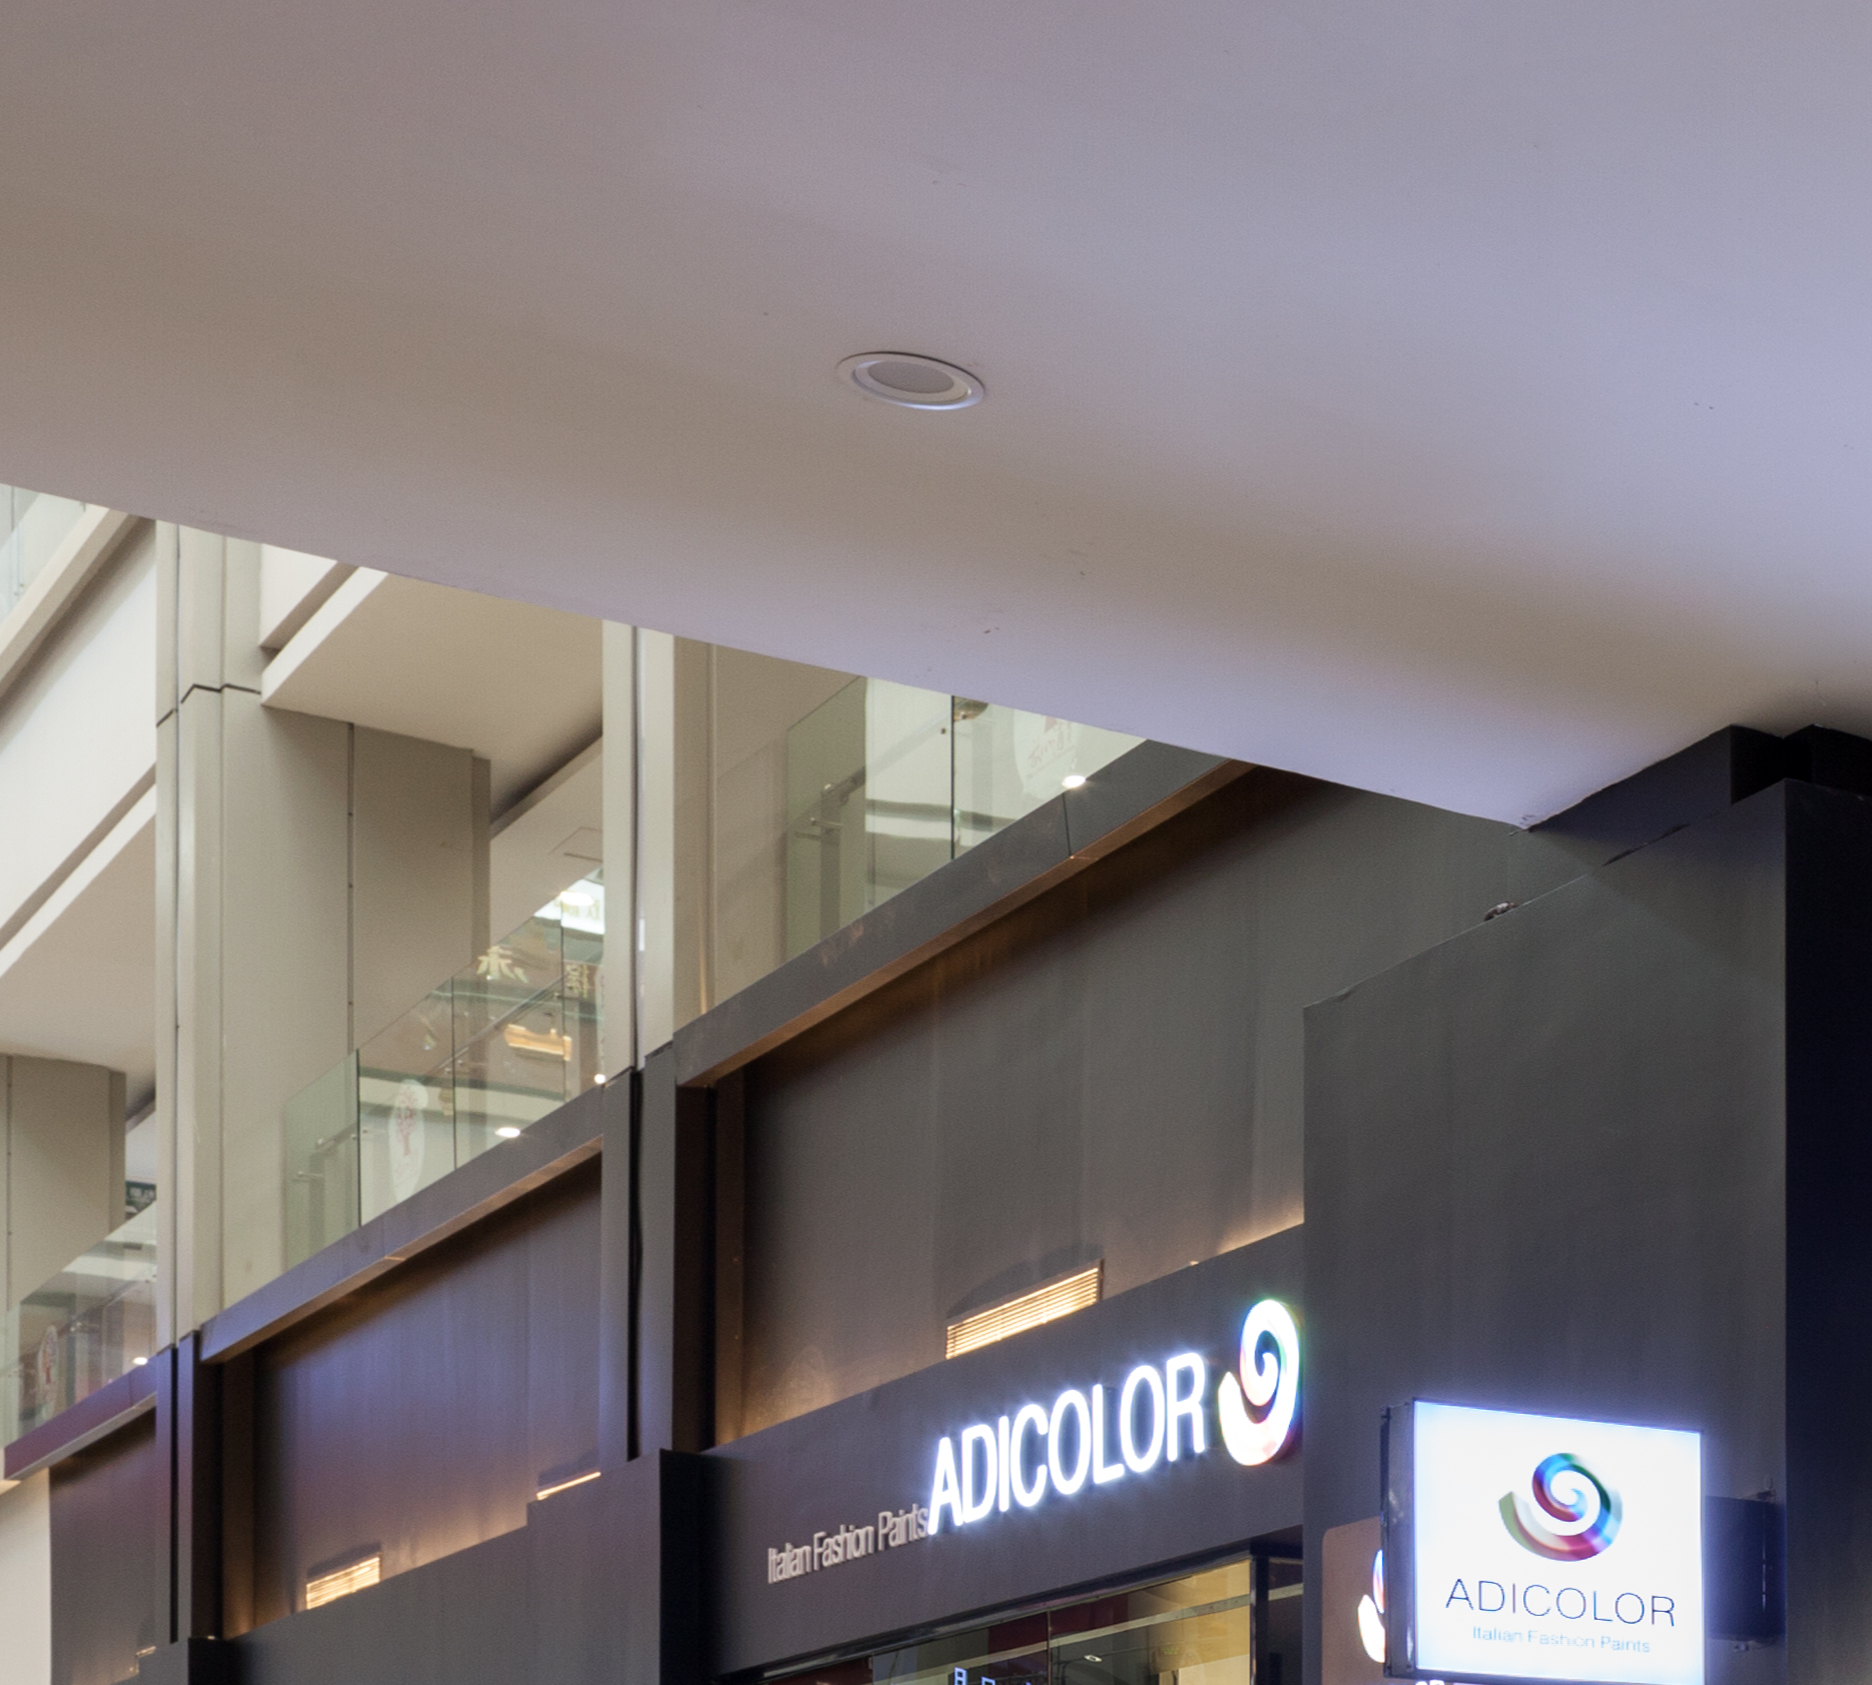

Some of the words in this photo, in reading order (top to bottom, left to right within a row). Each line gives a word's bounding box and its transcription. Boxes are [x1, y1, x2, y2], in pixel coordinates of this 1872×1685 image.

[768, 1541, 812, 1584] Italian
[813, 1525, 875, 1571] Fashion
[878, 1504, 929, 1550] Paints
[928, 1353, 1206, 1535] ADICOLOR
[1445, 1578, 1676, 1627] ADICOLOR
[1473, 1626, 1524, 1644] Italian
[1528, 1631, 1595, 1650] Fashion
[1600, 1635, 1652, 1654] Paints
